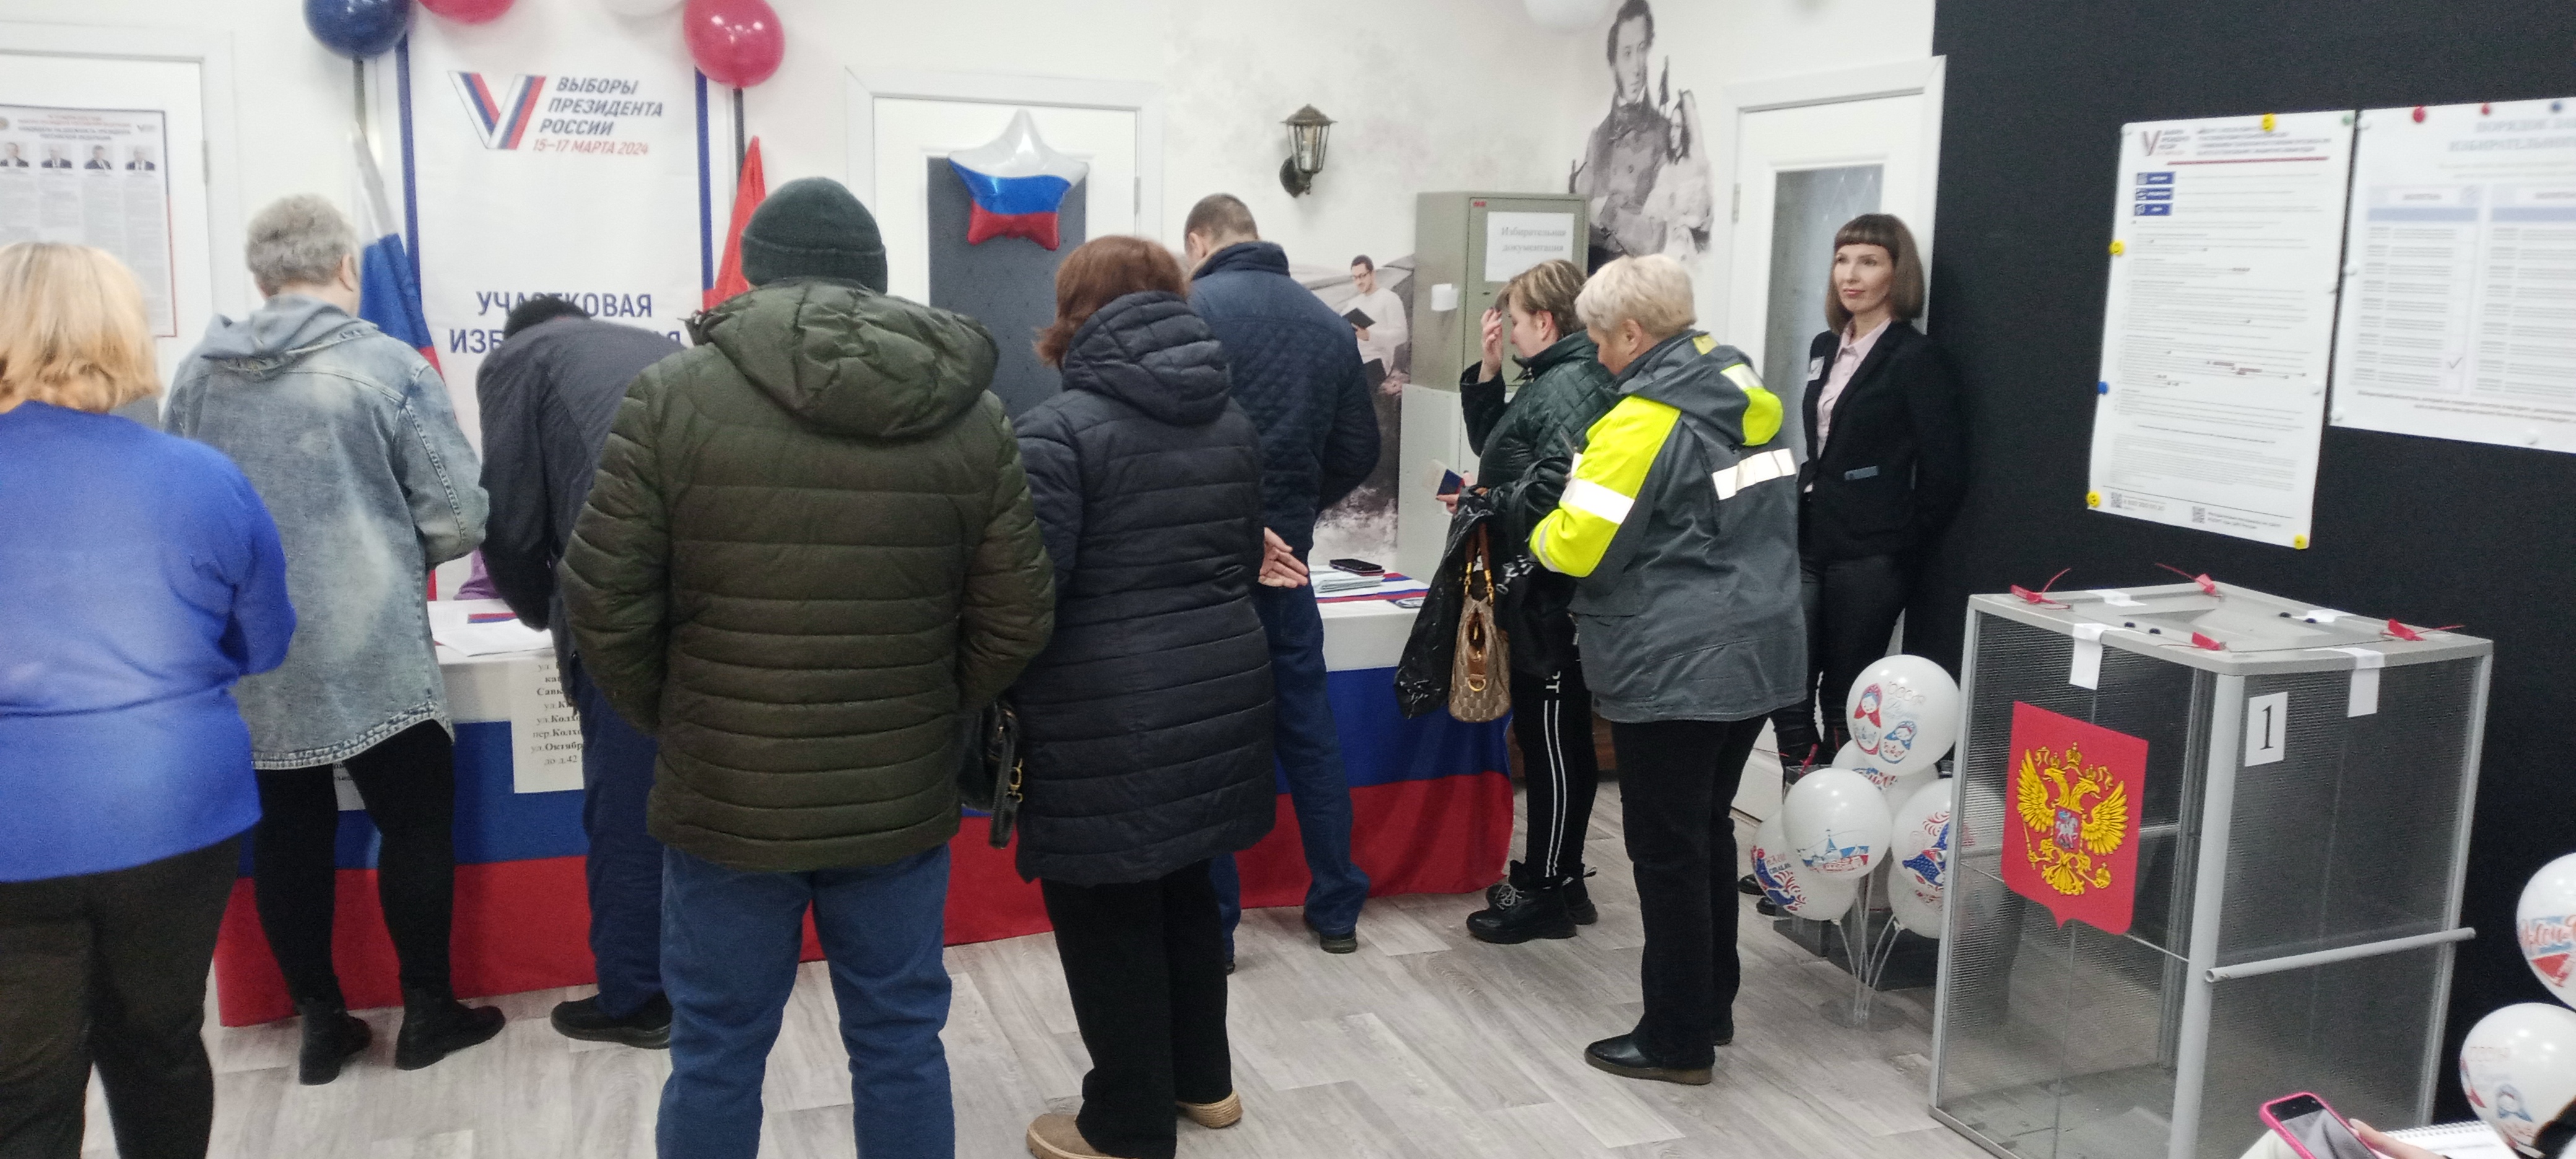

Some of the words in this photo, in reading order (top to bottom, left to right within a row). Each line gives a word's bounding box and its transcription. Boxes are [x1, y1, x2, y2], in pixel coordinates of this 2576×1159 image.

[556, 76, 638, 95] ВЫБОРЫ
[547, 97, 664, 118] ПРЕЗИДЕНТА
[539, 118, 614, 137] РОССИИ
[572, 140, 615, 154] МАРТА
[617, 141, 649, 155] 2024
[1501, 227, 1567, 238] Избирательная
[1502, 244, 1564, 254] документация
[2260, 705, 2274, 750] 1
